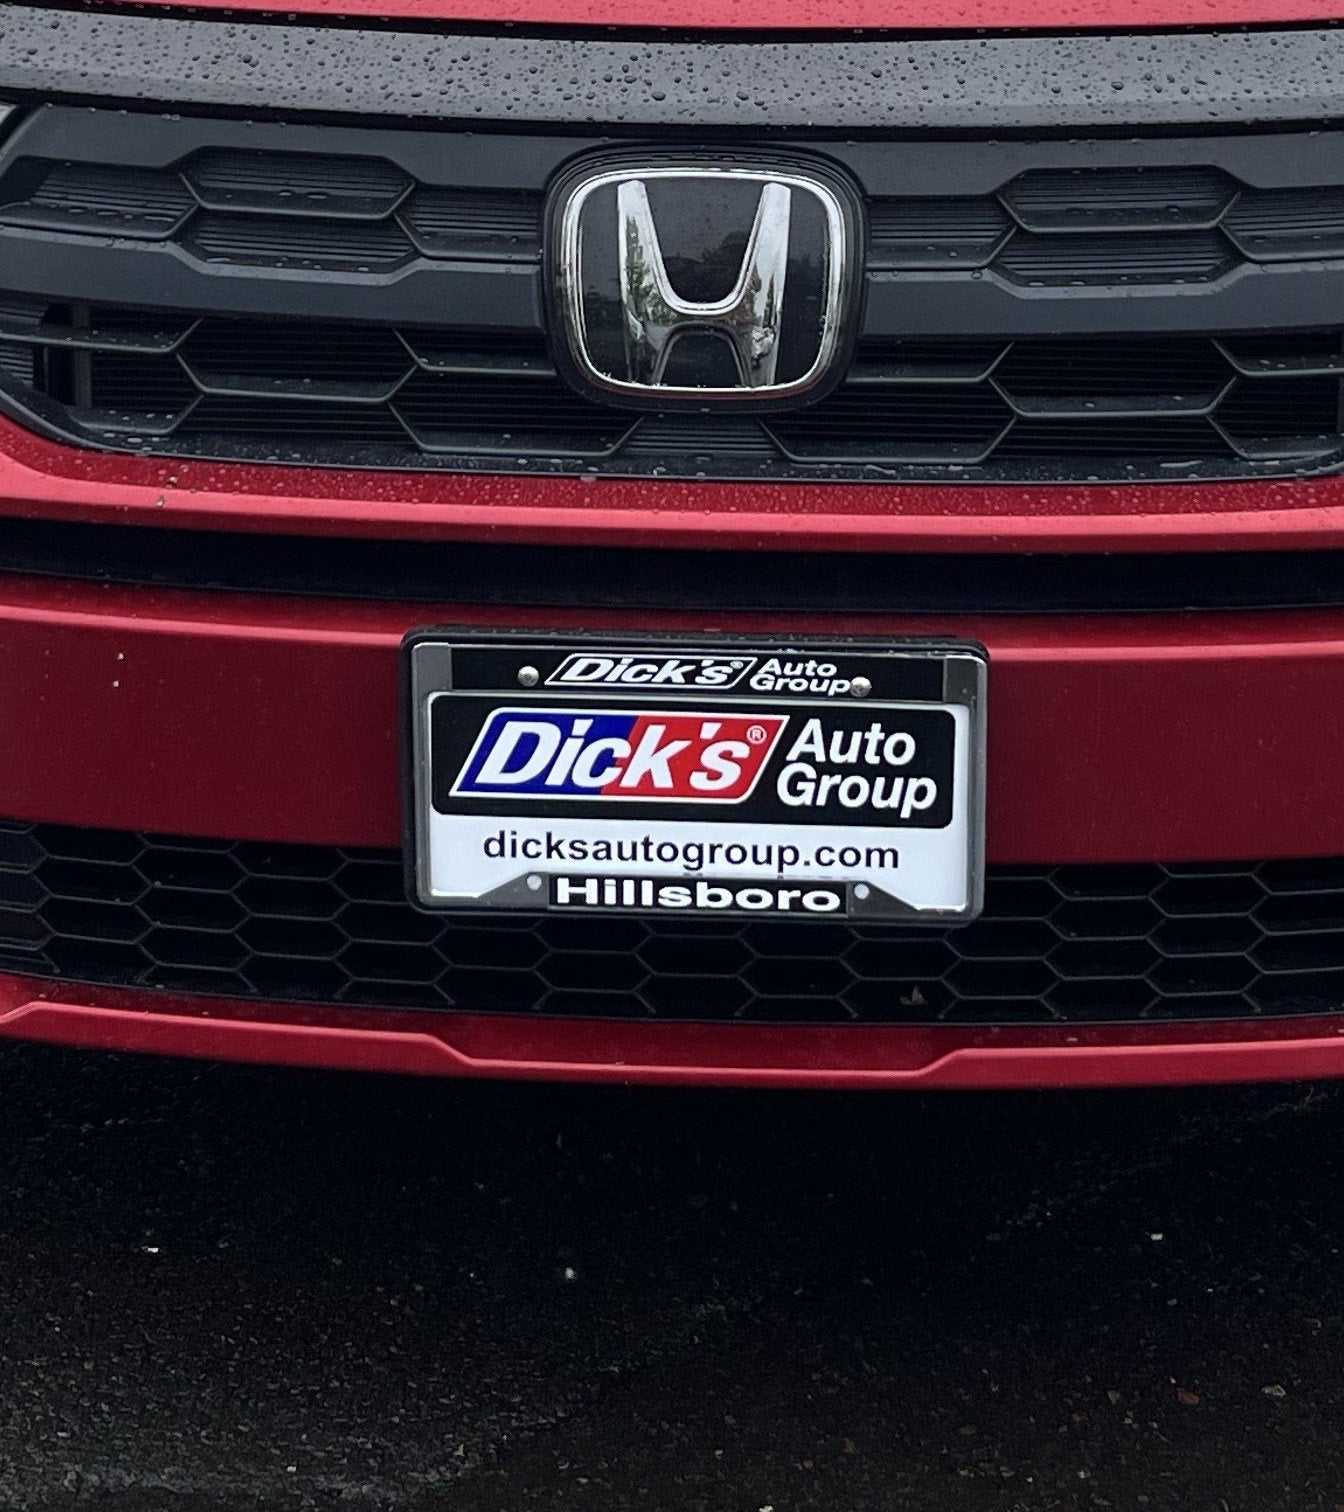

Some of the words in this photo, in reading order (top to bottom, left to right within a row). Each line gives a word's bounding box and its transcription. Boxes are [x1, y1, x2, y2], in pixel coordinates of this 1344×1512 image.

[749, 672, 852, 697] Group
[756, 657, 838, 677] Auto
[785, 718, 917, 765] Auto
[776, 761, 938, 819] Group
[482, 830, 900, 873] dicksautogroup.com
[555, 877, 842, 913] Hillsboro
